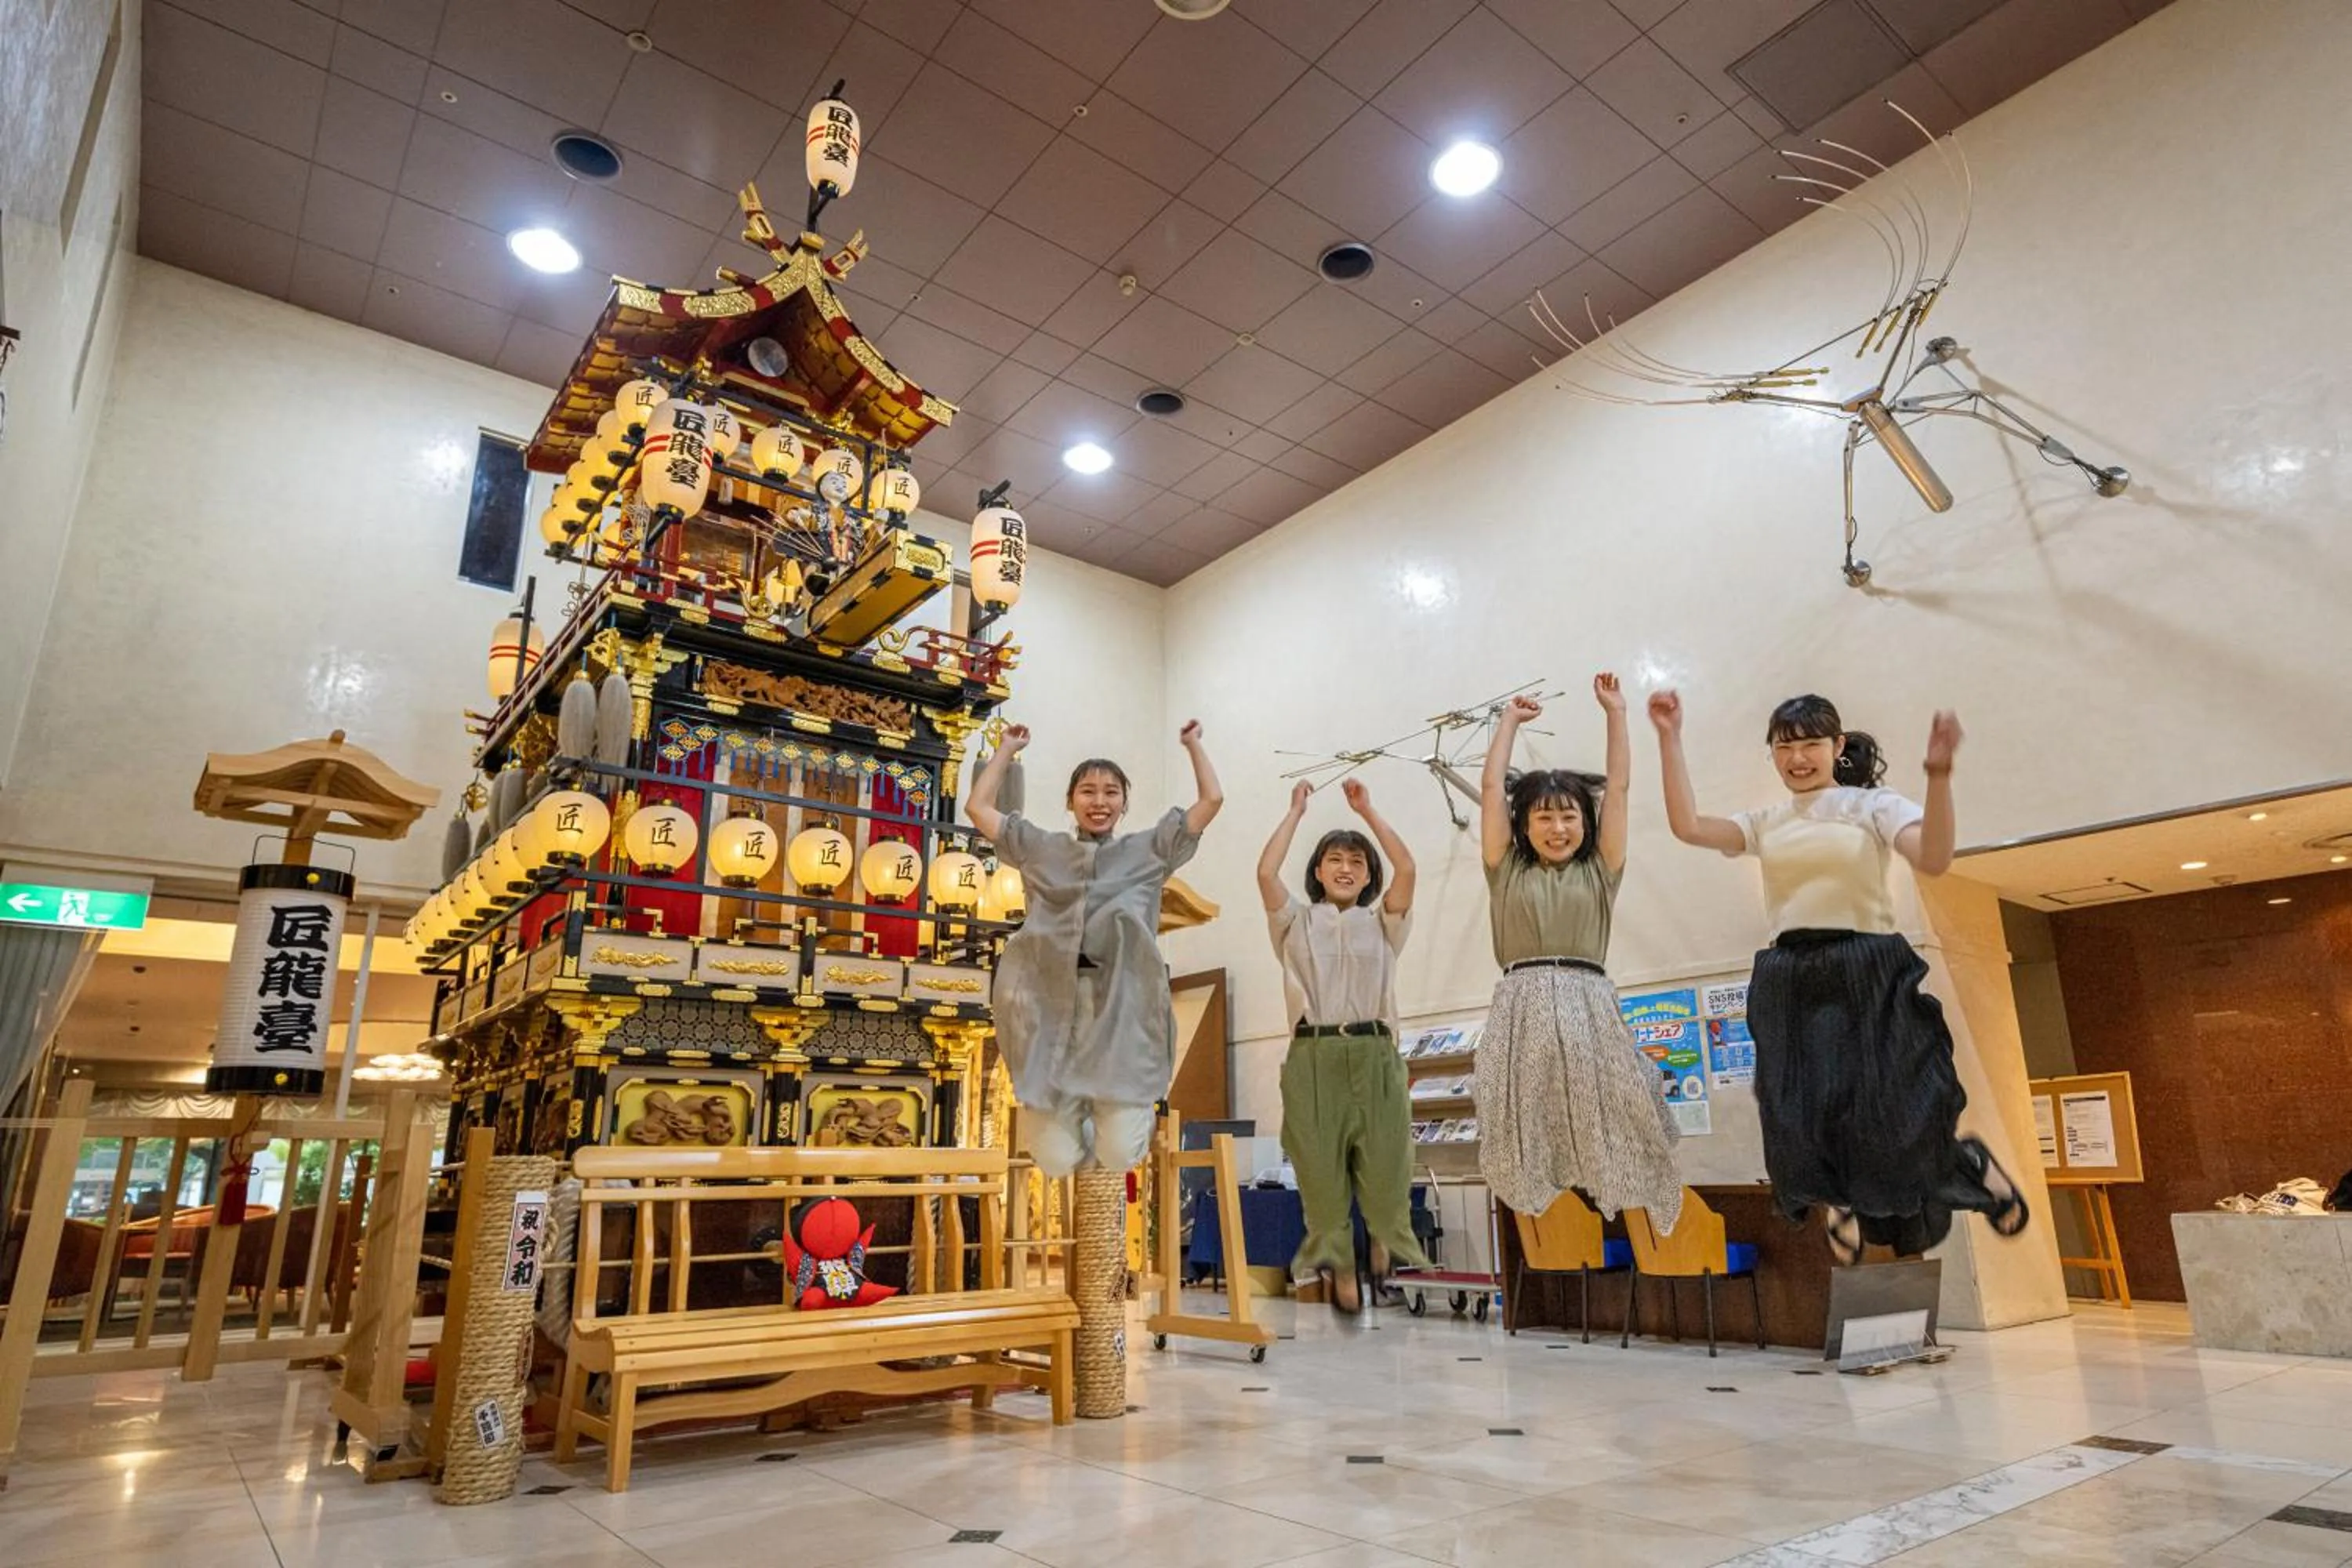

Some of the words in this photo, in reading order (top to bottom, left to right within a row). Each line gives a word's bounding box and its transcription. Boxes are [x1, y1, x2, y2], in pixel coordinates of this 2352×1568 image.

[636, 386, 655, 408] 匠
[714, 413, 730, 437] 匠
[779, 435, 794, 458] 匠
[837, 457, 853, 479] 匠
[895, 477, 910, 498] 匠
[556, 803, 584, 834] 匠
[652, 817, 677, 848] 匠
[744, 831, 766, 860] 匠
[821, 840, 841, 869] 匠
[896, 855, 914, 882] 匠
[958, 863, 977, 889] 匠
